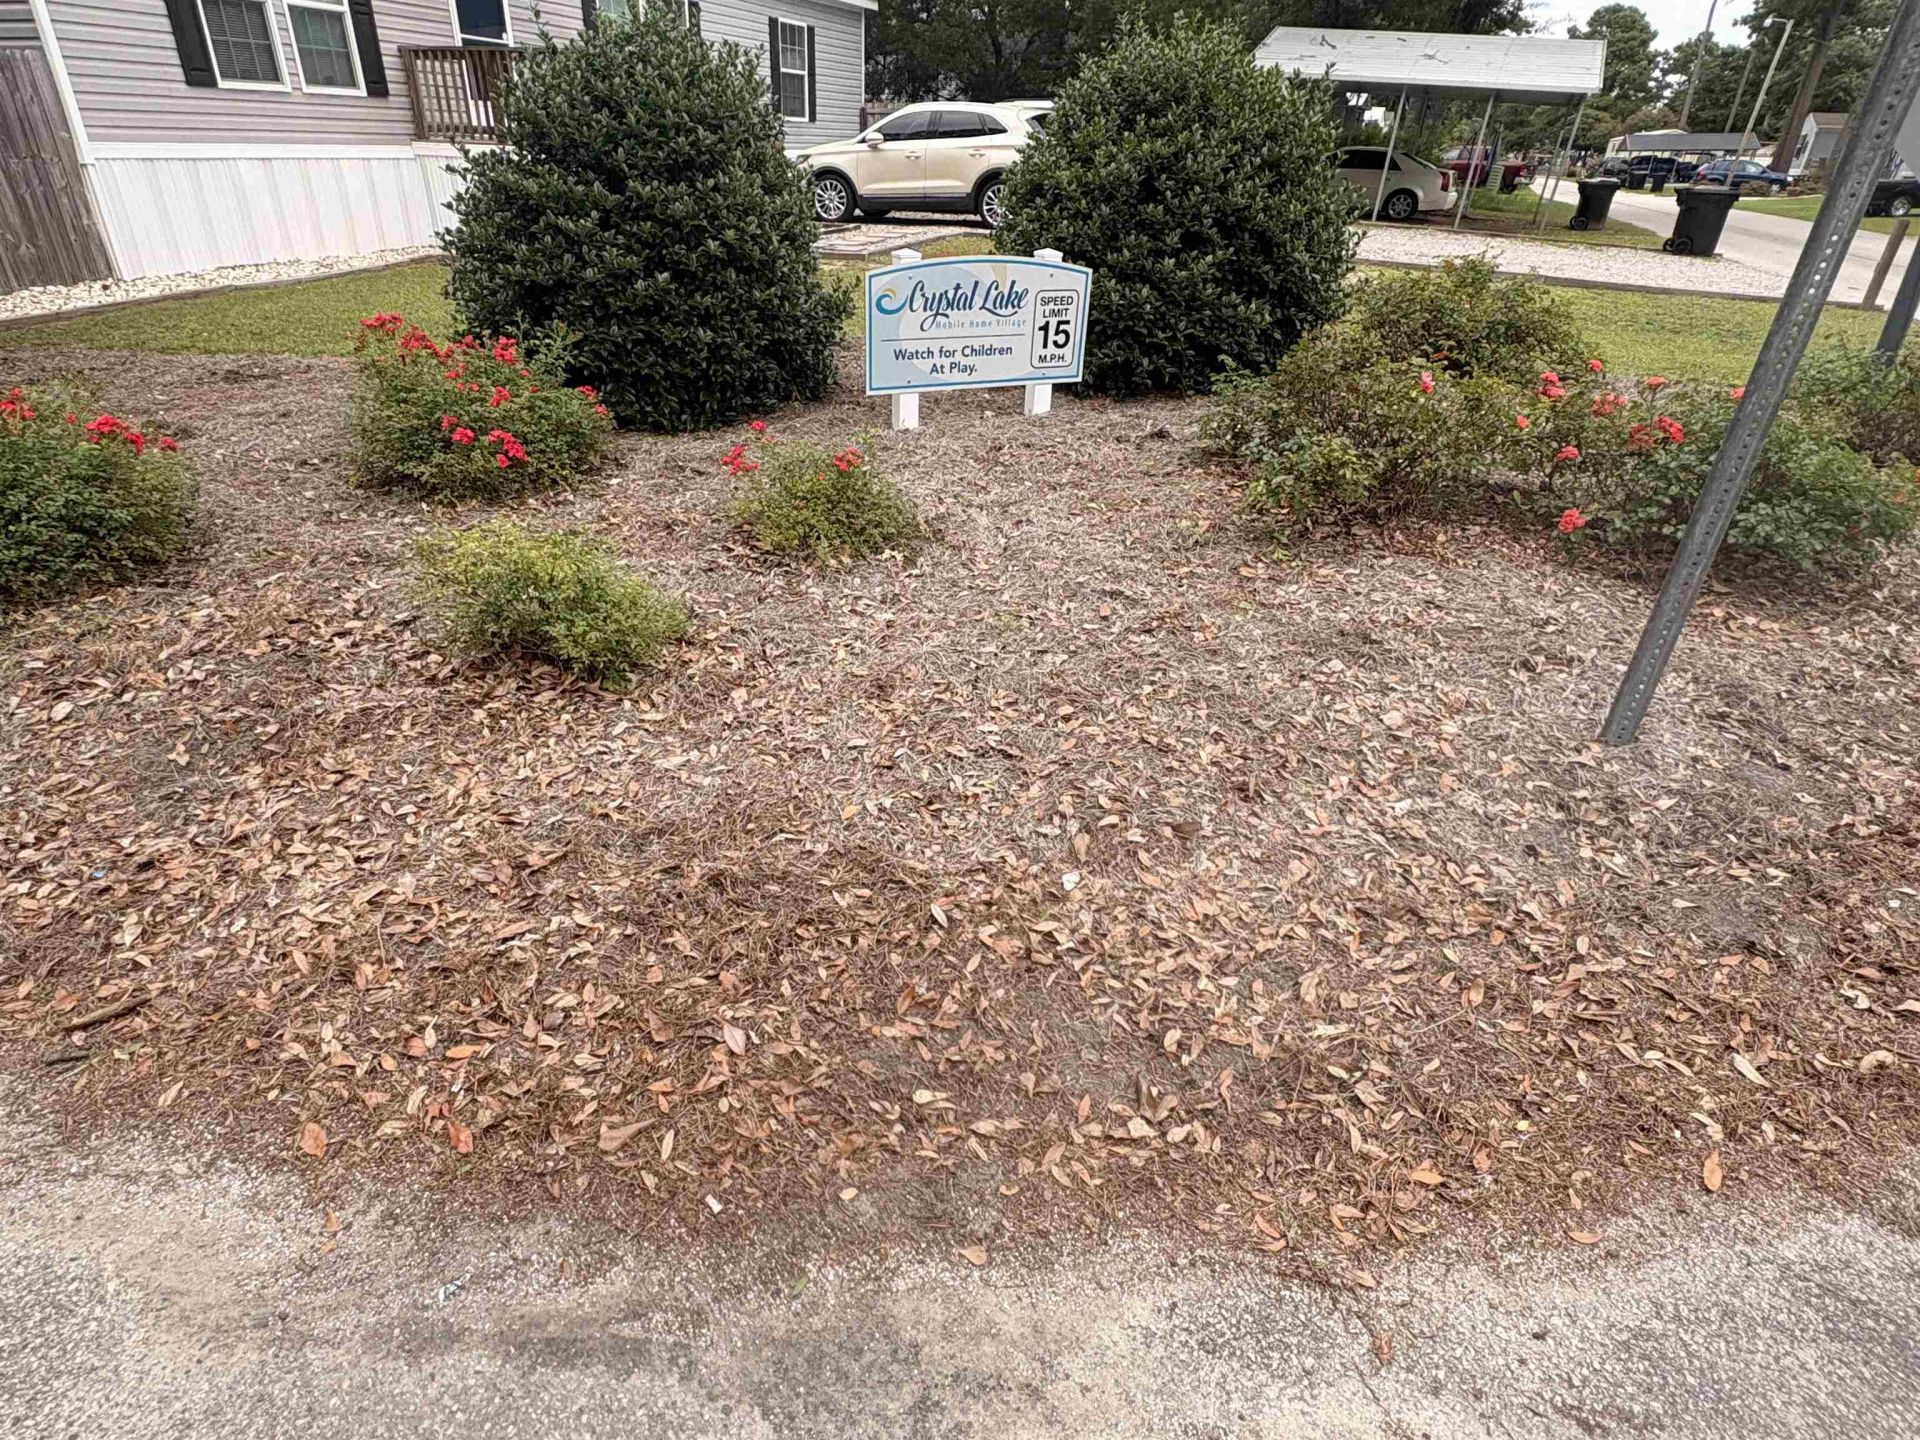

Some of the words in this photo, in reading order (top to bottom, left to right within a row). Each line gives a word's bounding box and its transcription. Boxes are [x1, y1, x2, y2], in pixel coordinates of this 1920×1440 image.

[906, 279, 979, 332] Crystal
[980, 279, 1030, 318] Lake
[1040, 295, 1074, 307] SPEED
[1042, 307, 1070, 319] LIMIT
[935, 321, 965, 329] Mobile
[969, 319, 993, 329] Home
[995, 318, 1027, 329] Village
[1037, 320, 1071, 350] 15
[893, 346, 934, 361] Watch
[938, 345, 958, 359] for
[961, 344, 1013, 358] Children
[1037, 353, 1067, 364] M.P.H.
[929, 363, 945, 375] At
[949, 361, 978, 376] Play.
